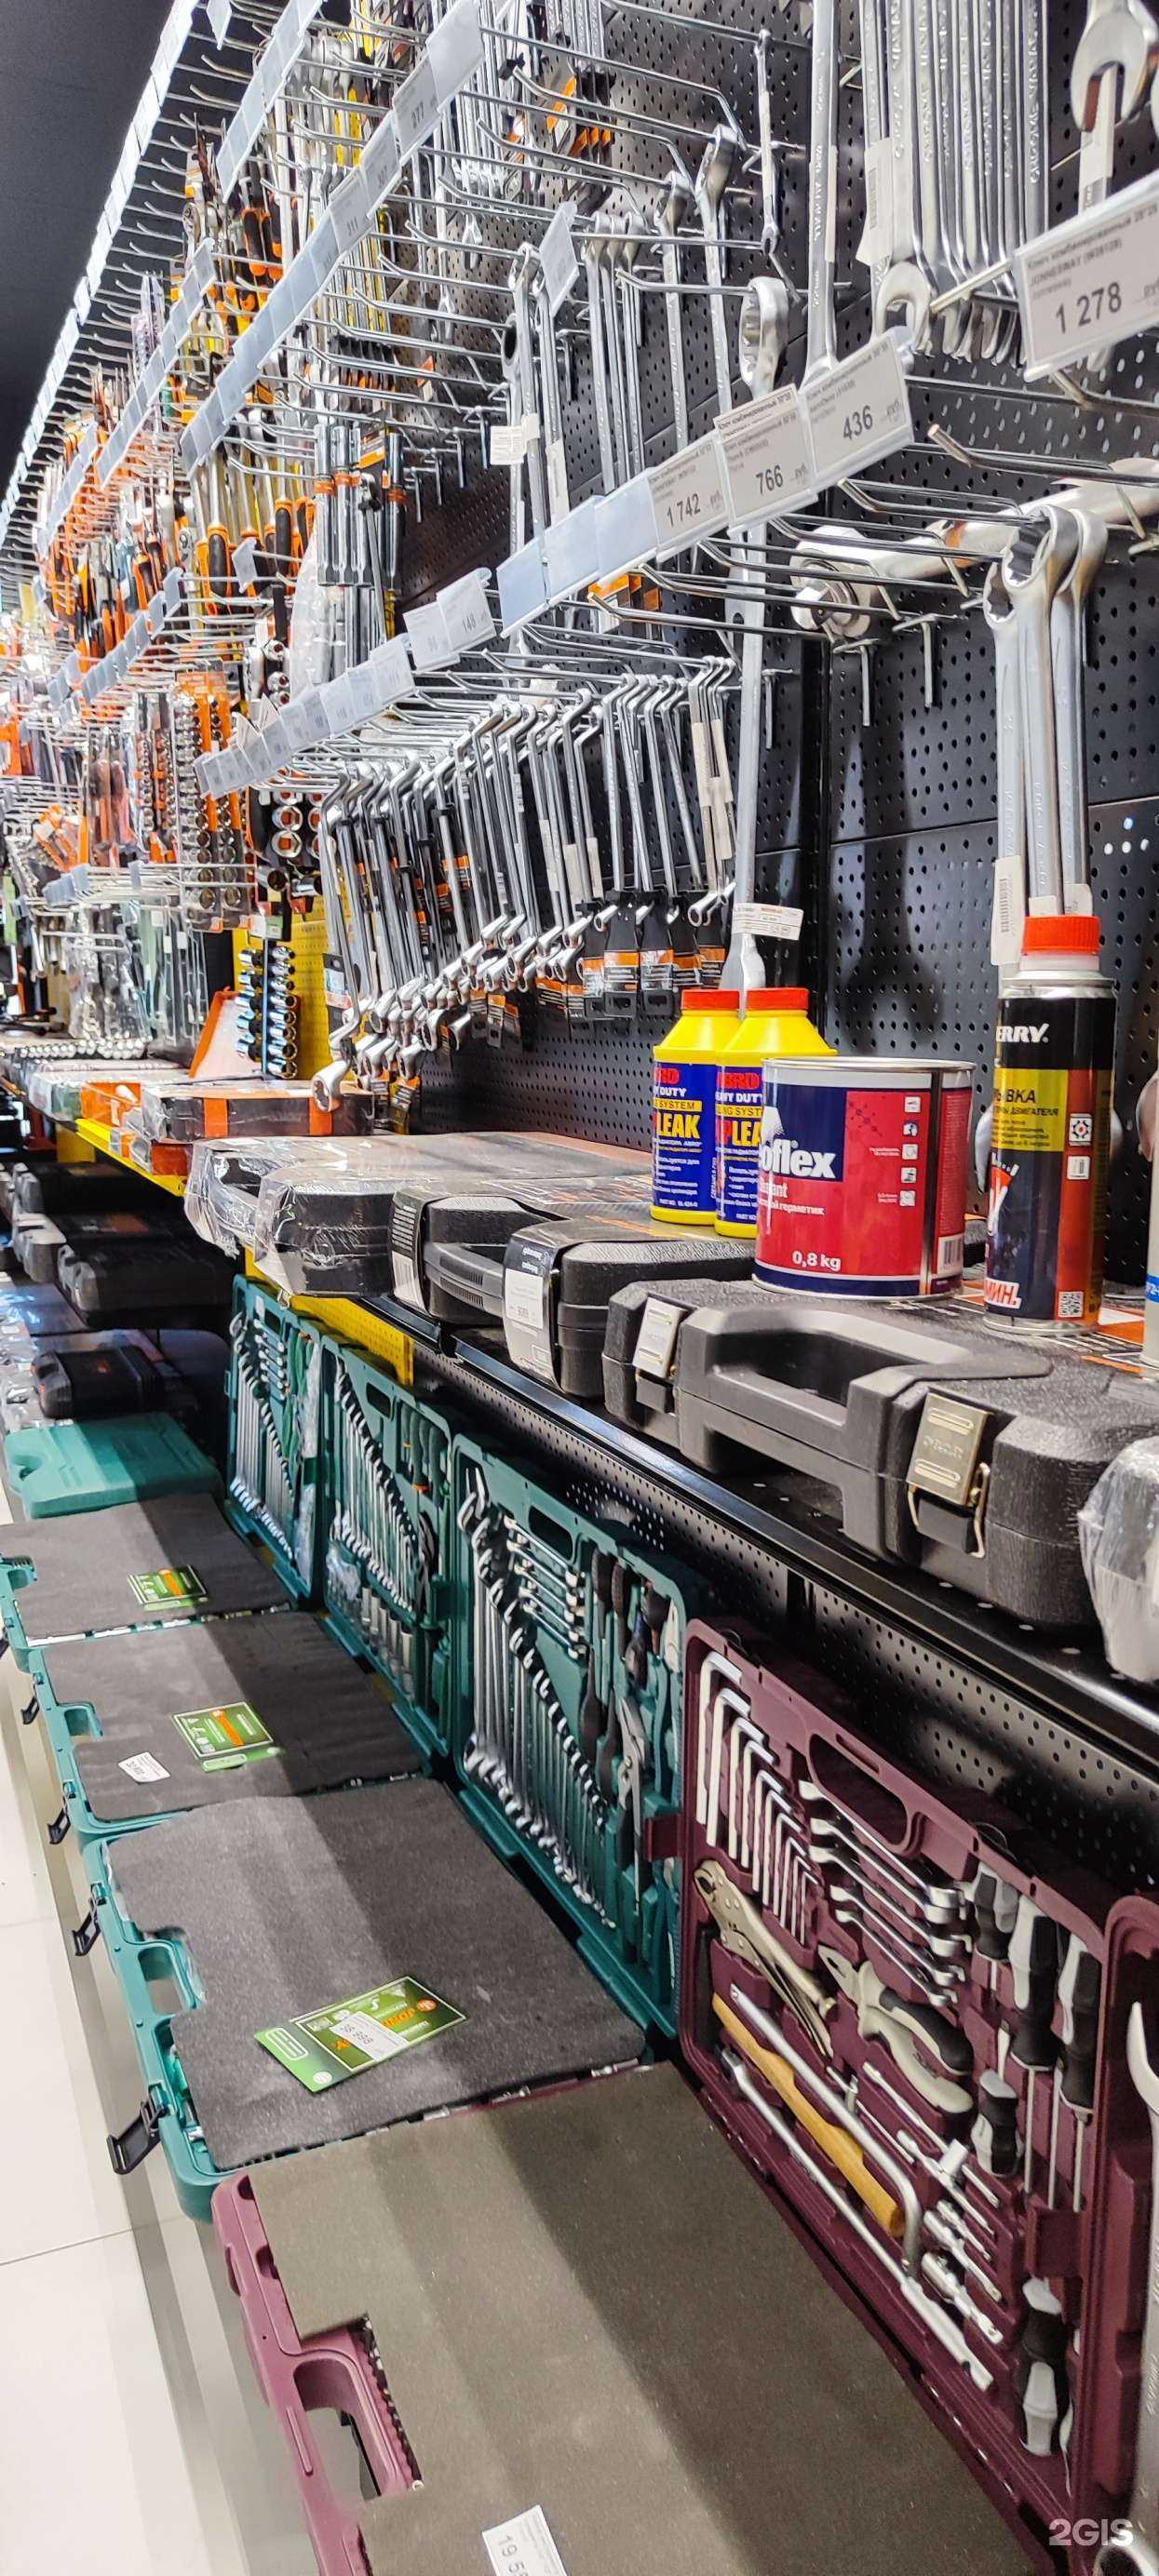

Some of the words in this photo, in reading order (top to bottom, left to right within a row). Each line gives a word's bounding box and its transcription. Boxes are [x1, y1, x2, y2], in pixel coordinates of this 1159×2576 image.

[1055, 302, 1066, 333] 1
[1076, 282, 1122, 327] 278
[842, 405, 873, 440] 436
[755, 464, 783, 494] 766
[667, 506, 674, 527] 1
[677, 492, 700, 521] 742
[995, 1023, 1049, 1043] ERRY
[659, 1087, 687, 1097] DUTY
[659, 1100, 695, 1110] SYSTEM
[656, 1112, 701, 1139] LEAK
[732, 1120, 761, 1147] LEA
[792, 1251, 818, 1268] 0,8
[820, 1254, 842, 1271] kg
